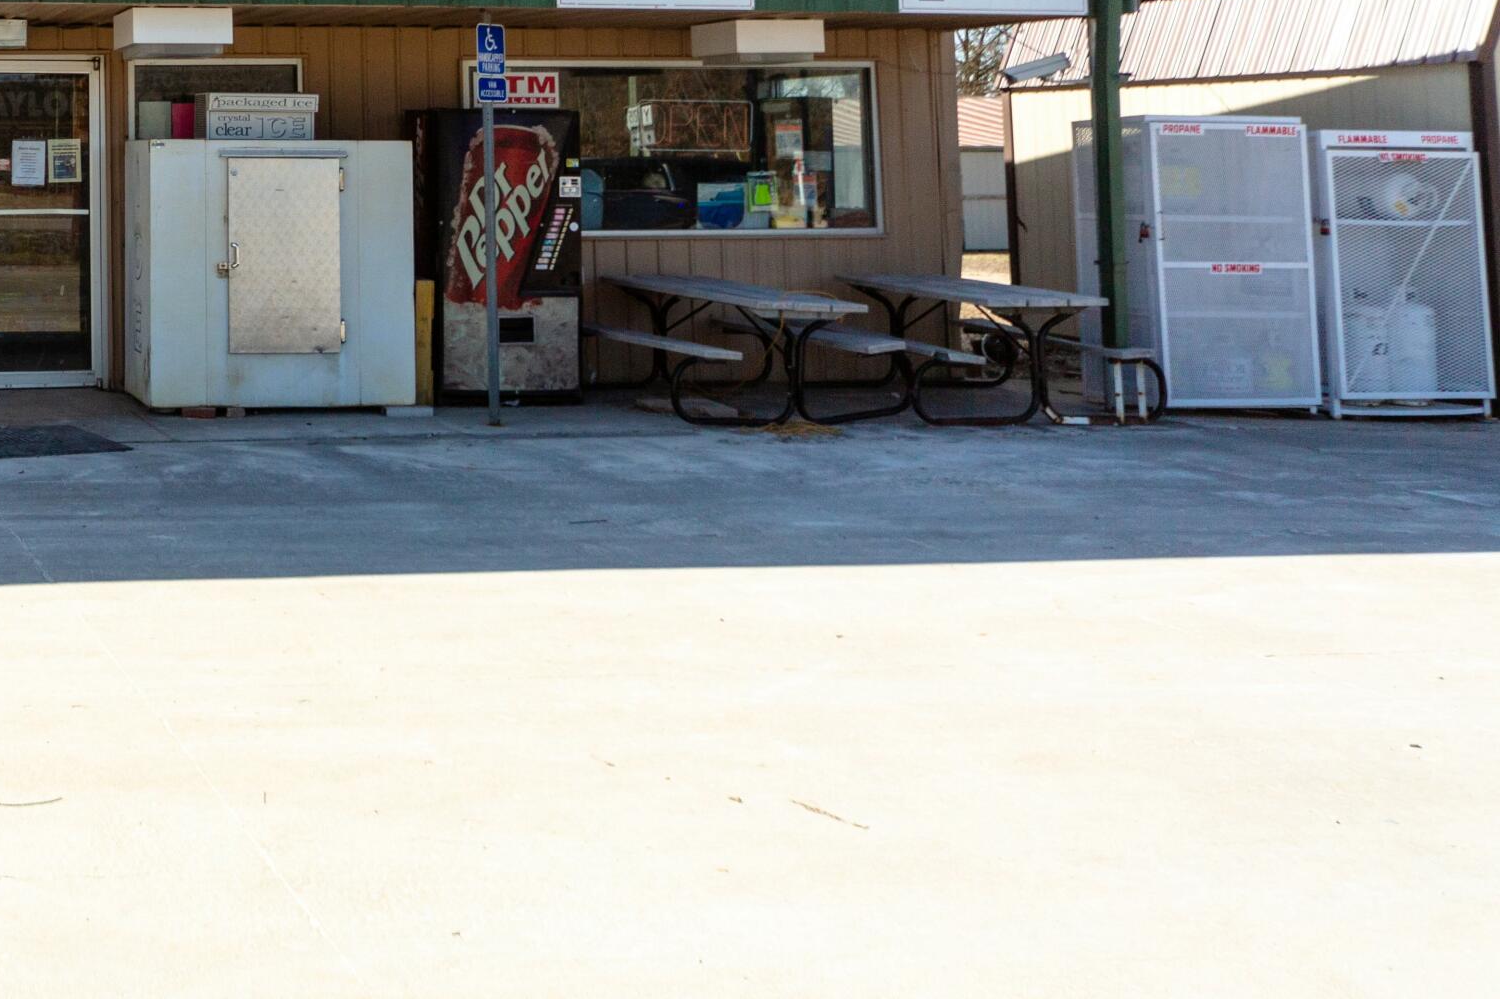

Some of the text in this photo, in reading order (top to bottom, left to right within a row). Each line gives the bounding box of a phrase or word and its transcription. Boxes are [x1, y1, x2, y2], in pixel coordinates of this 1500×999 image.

[481, 62, 501, 73] PARKING
[505, 76, 556, 93] TM
[215, 97, 288, 109] packaged
[217, 114, 251, 123] crystal
[215, 123, 252, 137] clear
[255, 116, 307, 139] ICE
[1162, 124, 1201, 134] PROPANE
[1246, 125, 1296, 136] FLAMMABLE
[1337, 135, 1388, 144] FLAMMABLE
[1420, 135, 1459, 144] PROPANE
[1211, 263, 1260, 273] NO SMOKING
